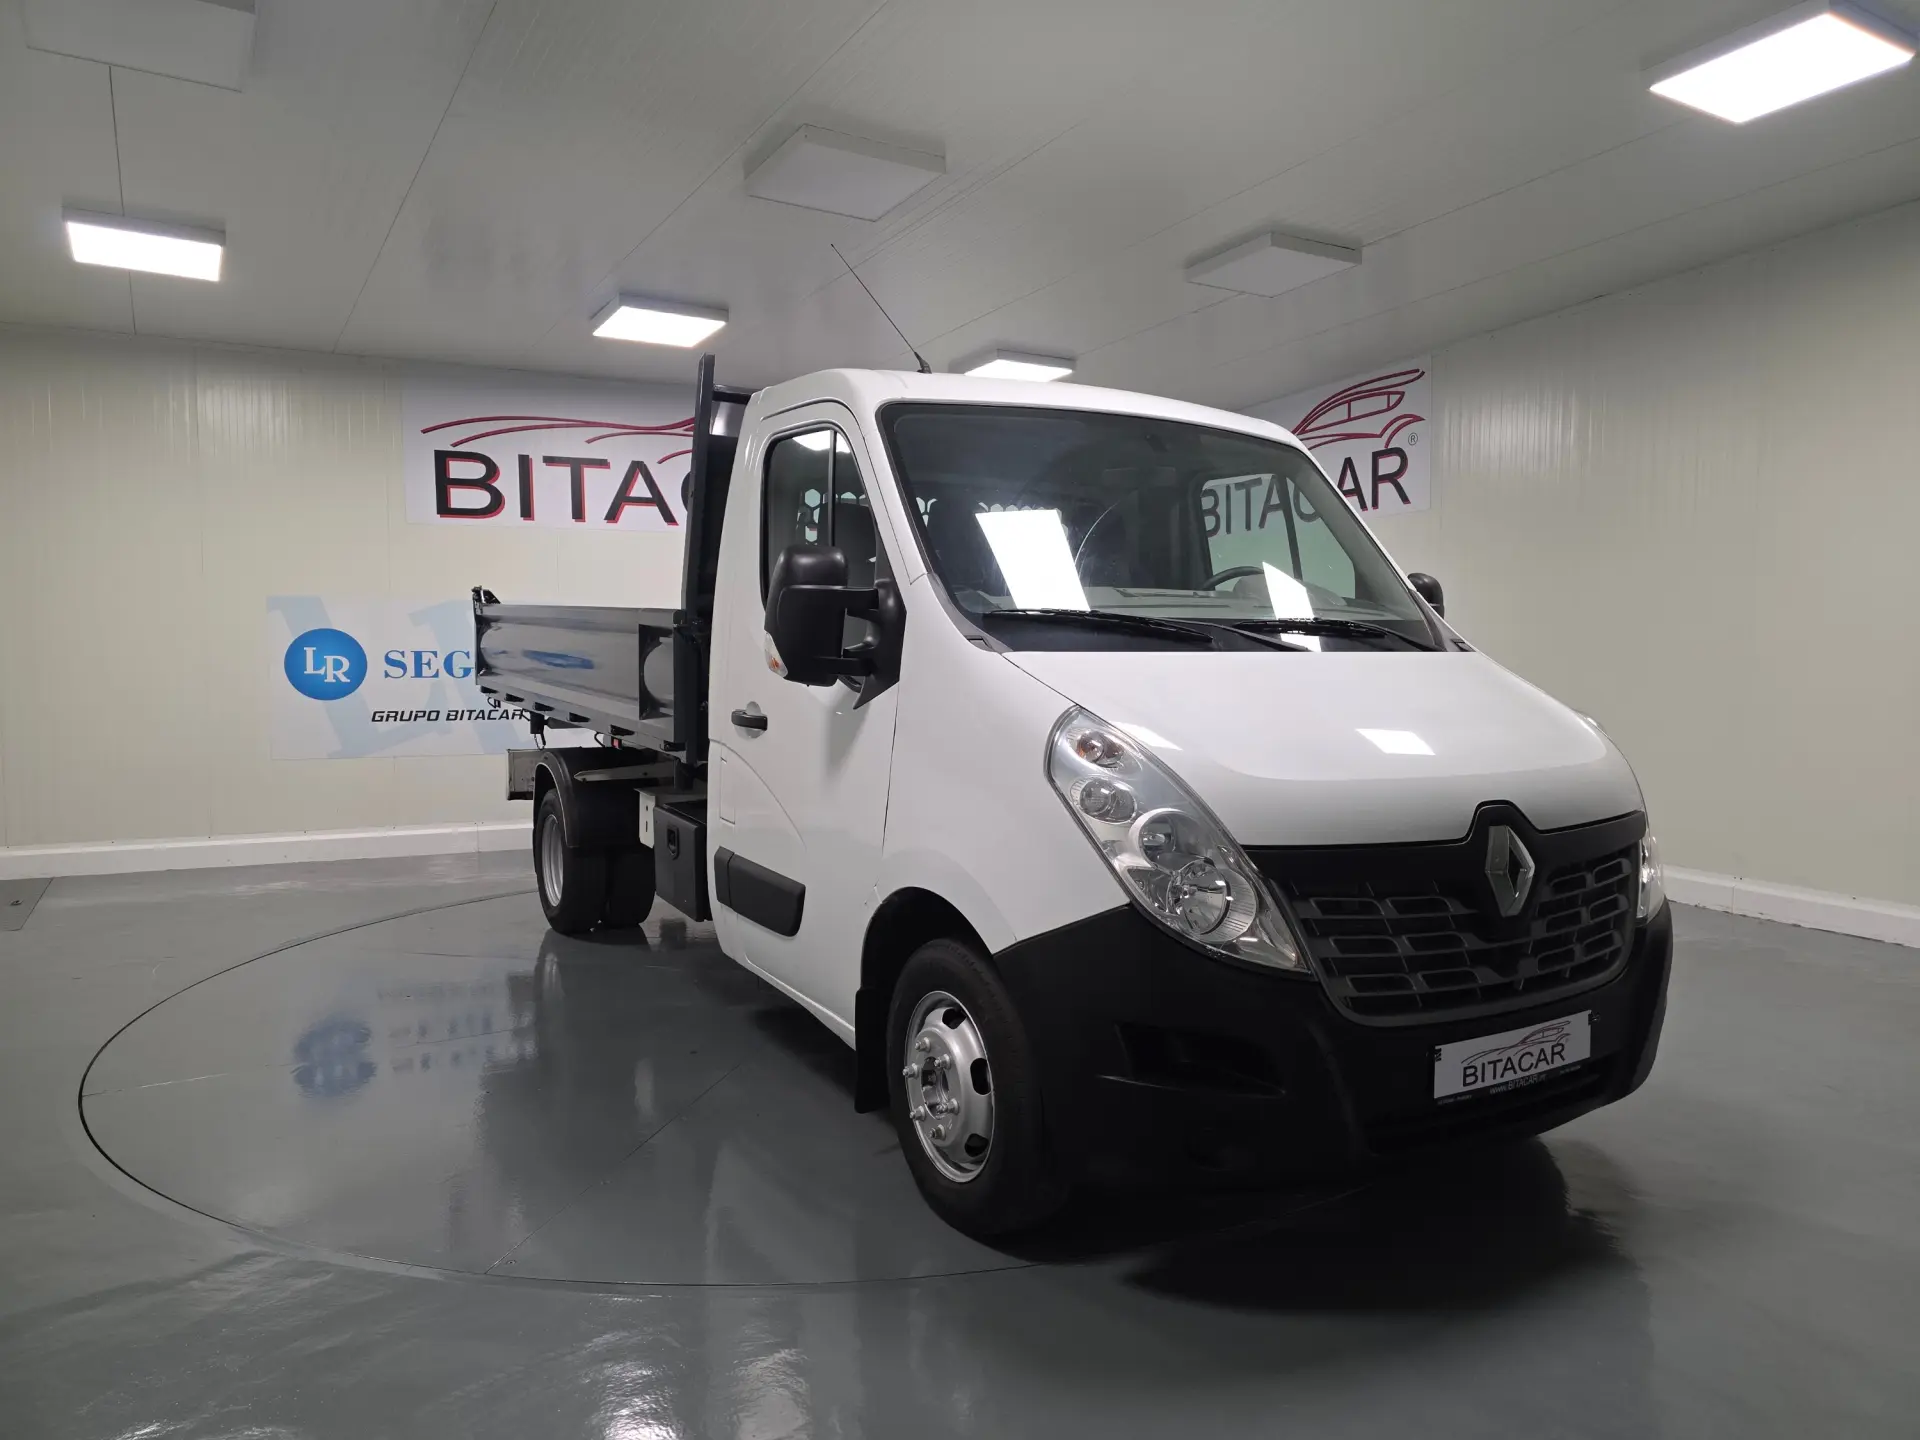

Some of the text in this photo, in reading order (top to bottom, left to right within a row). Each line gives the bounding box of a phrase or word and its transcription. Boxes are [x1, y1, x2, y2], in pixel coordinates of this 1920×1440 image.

[434, 449, 692, 526] BITA
[303, 646, 351, 683] LR
[371, 708, 523, 723] GRUPO BITACAR
[1462, 1043, 1566, 1088] BITACAR
